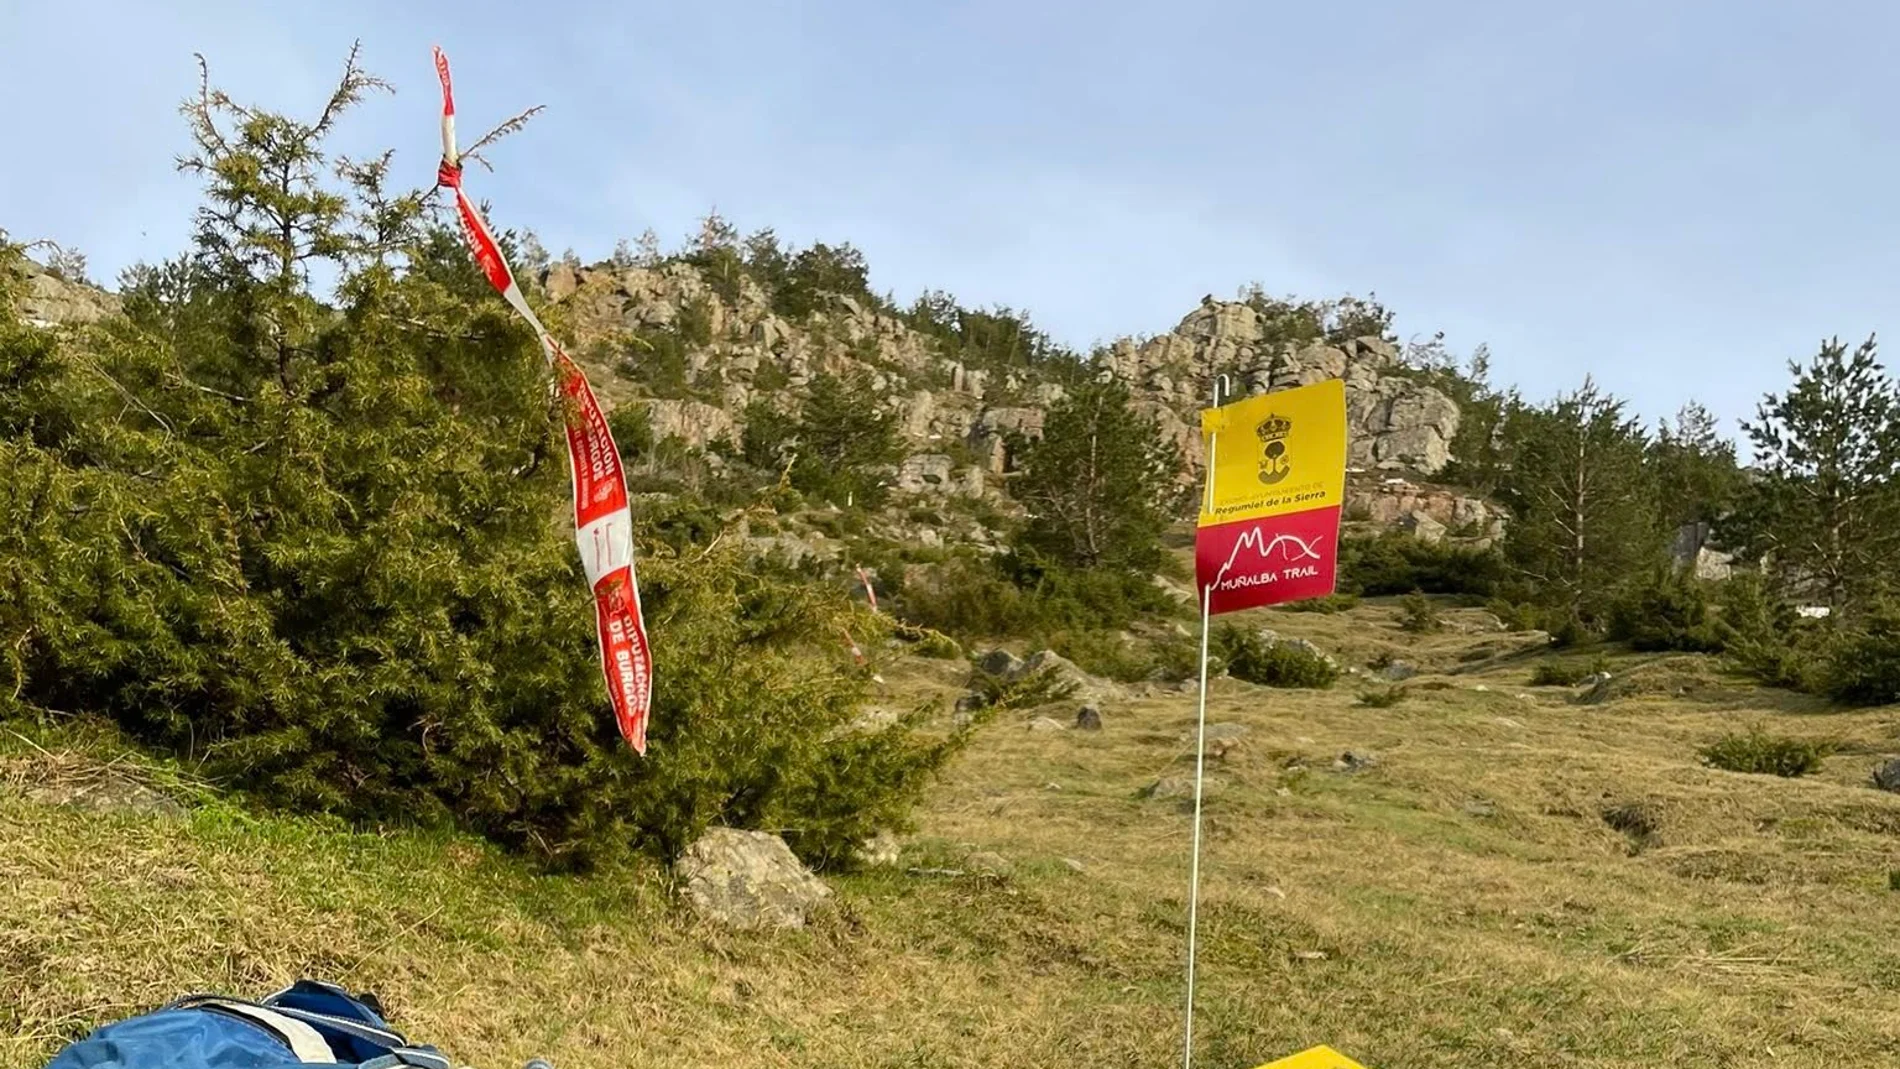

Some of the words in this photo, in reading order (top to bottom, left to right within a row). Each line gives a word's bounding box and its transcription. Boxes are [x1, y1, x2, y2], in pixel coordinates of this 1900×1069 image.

[1214, 500, 1264, 515] Regumiel
[1266, 498, 1280, 508] de
[1282, 496, 1292, 505] la
[1295, 490, 1326, 503] Sierra
[1283, 565, 1319, 580] TRAIL
[609, 620, 626, 646] DE
[615, 650, 638, 718] BURGOS
